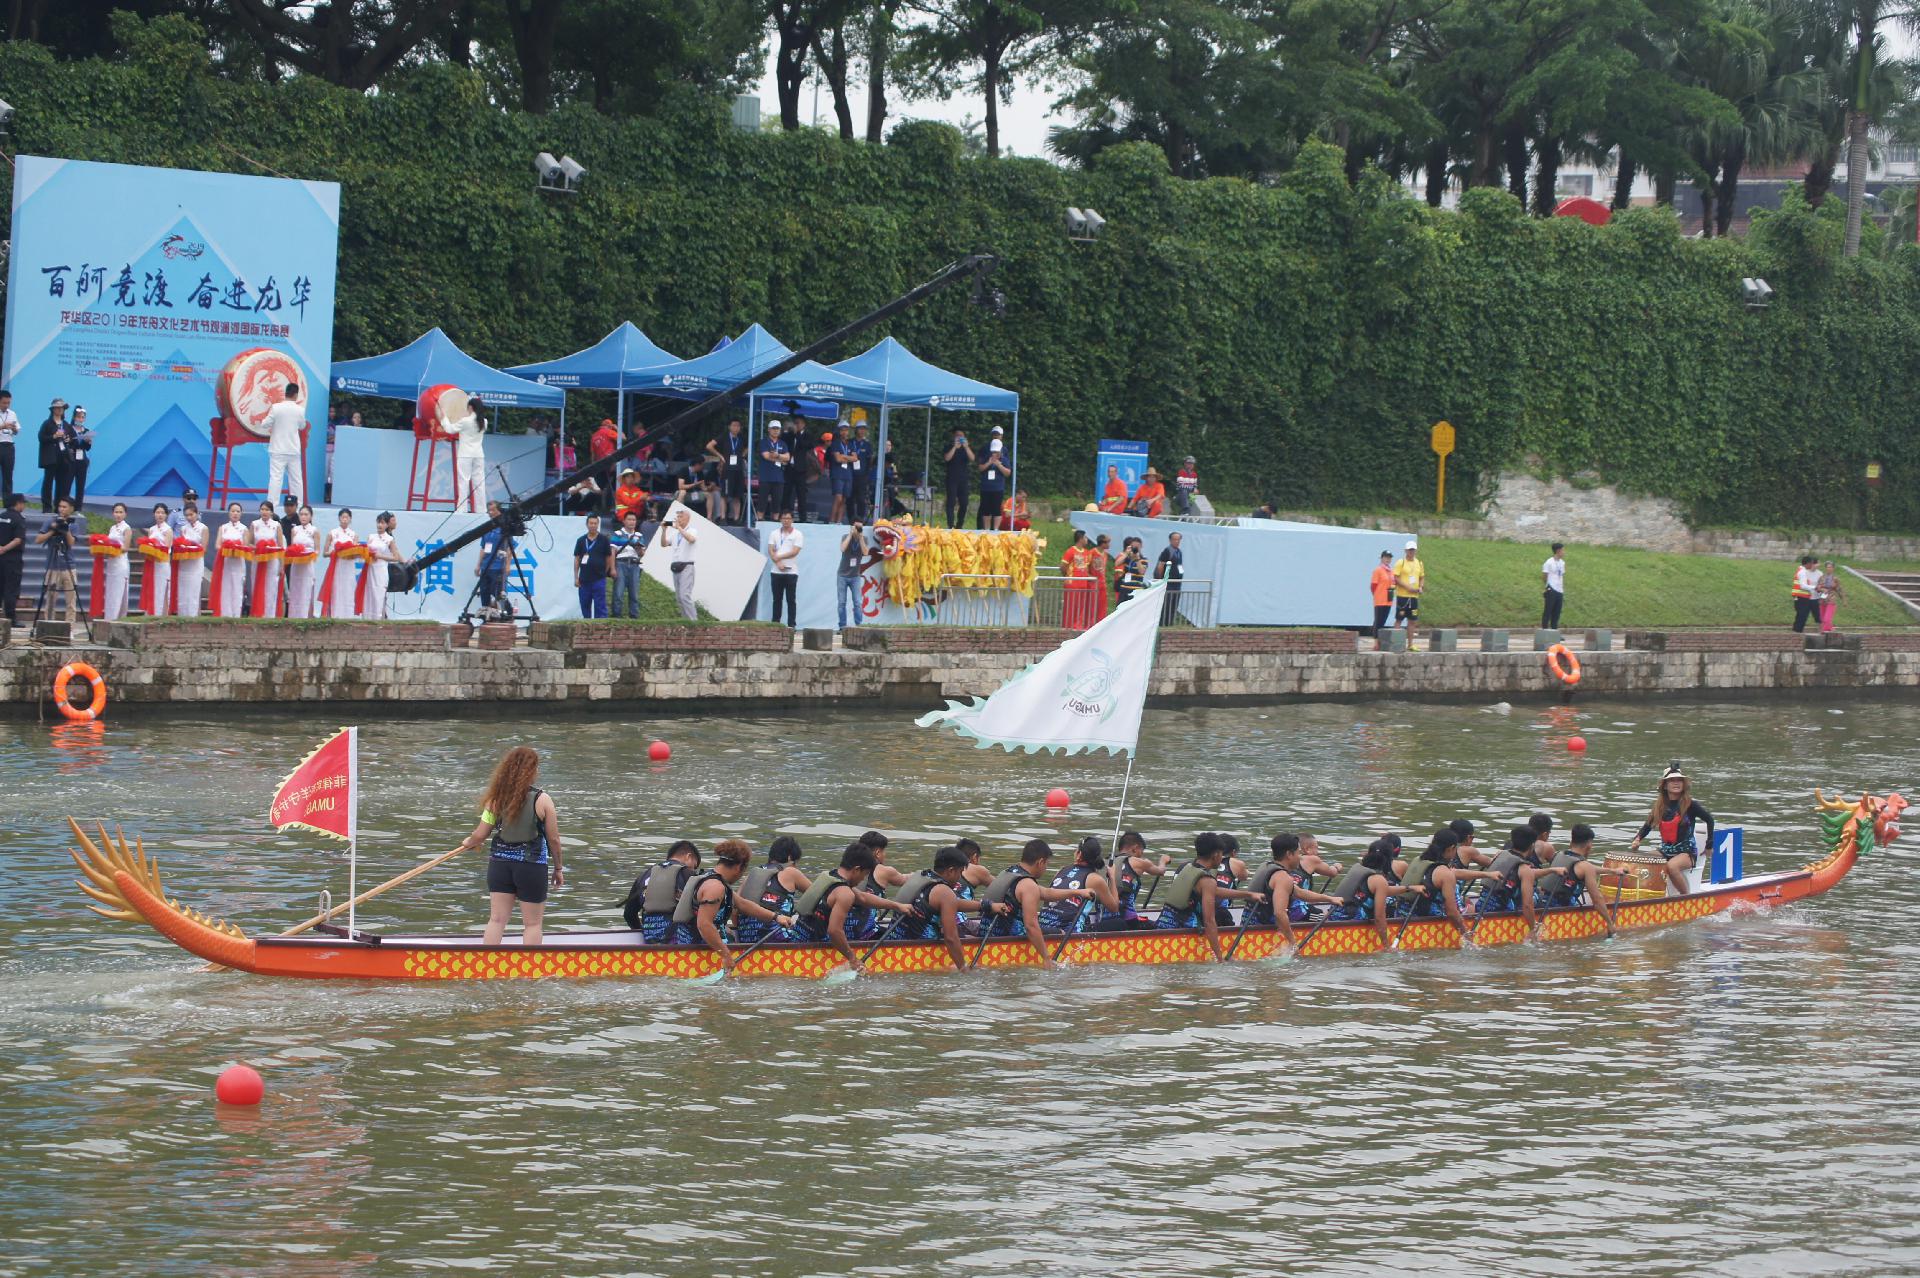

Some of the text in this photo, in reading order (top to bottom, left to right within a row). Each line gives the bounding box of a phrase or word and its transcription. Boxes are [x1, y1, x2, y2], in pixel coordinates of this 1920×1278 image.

[188, 271, 312, 322] 奋进龙华
[1719, 832, 1734, 879] 1
